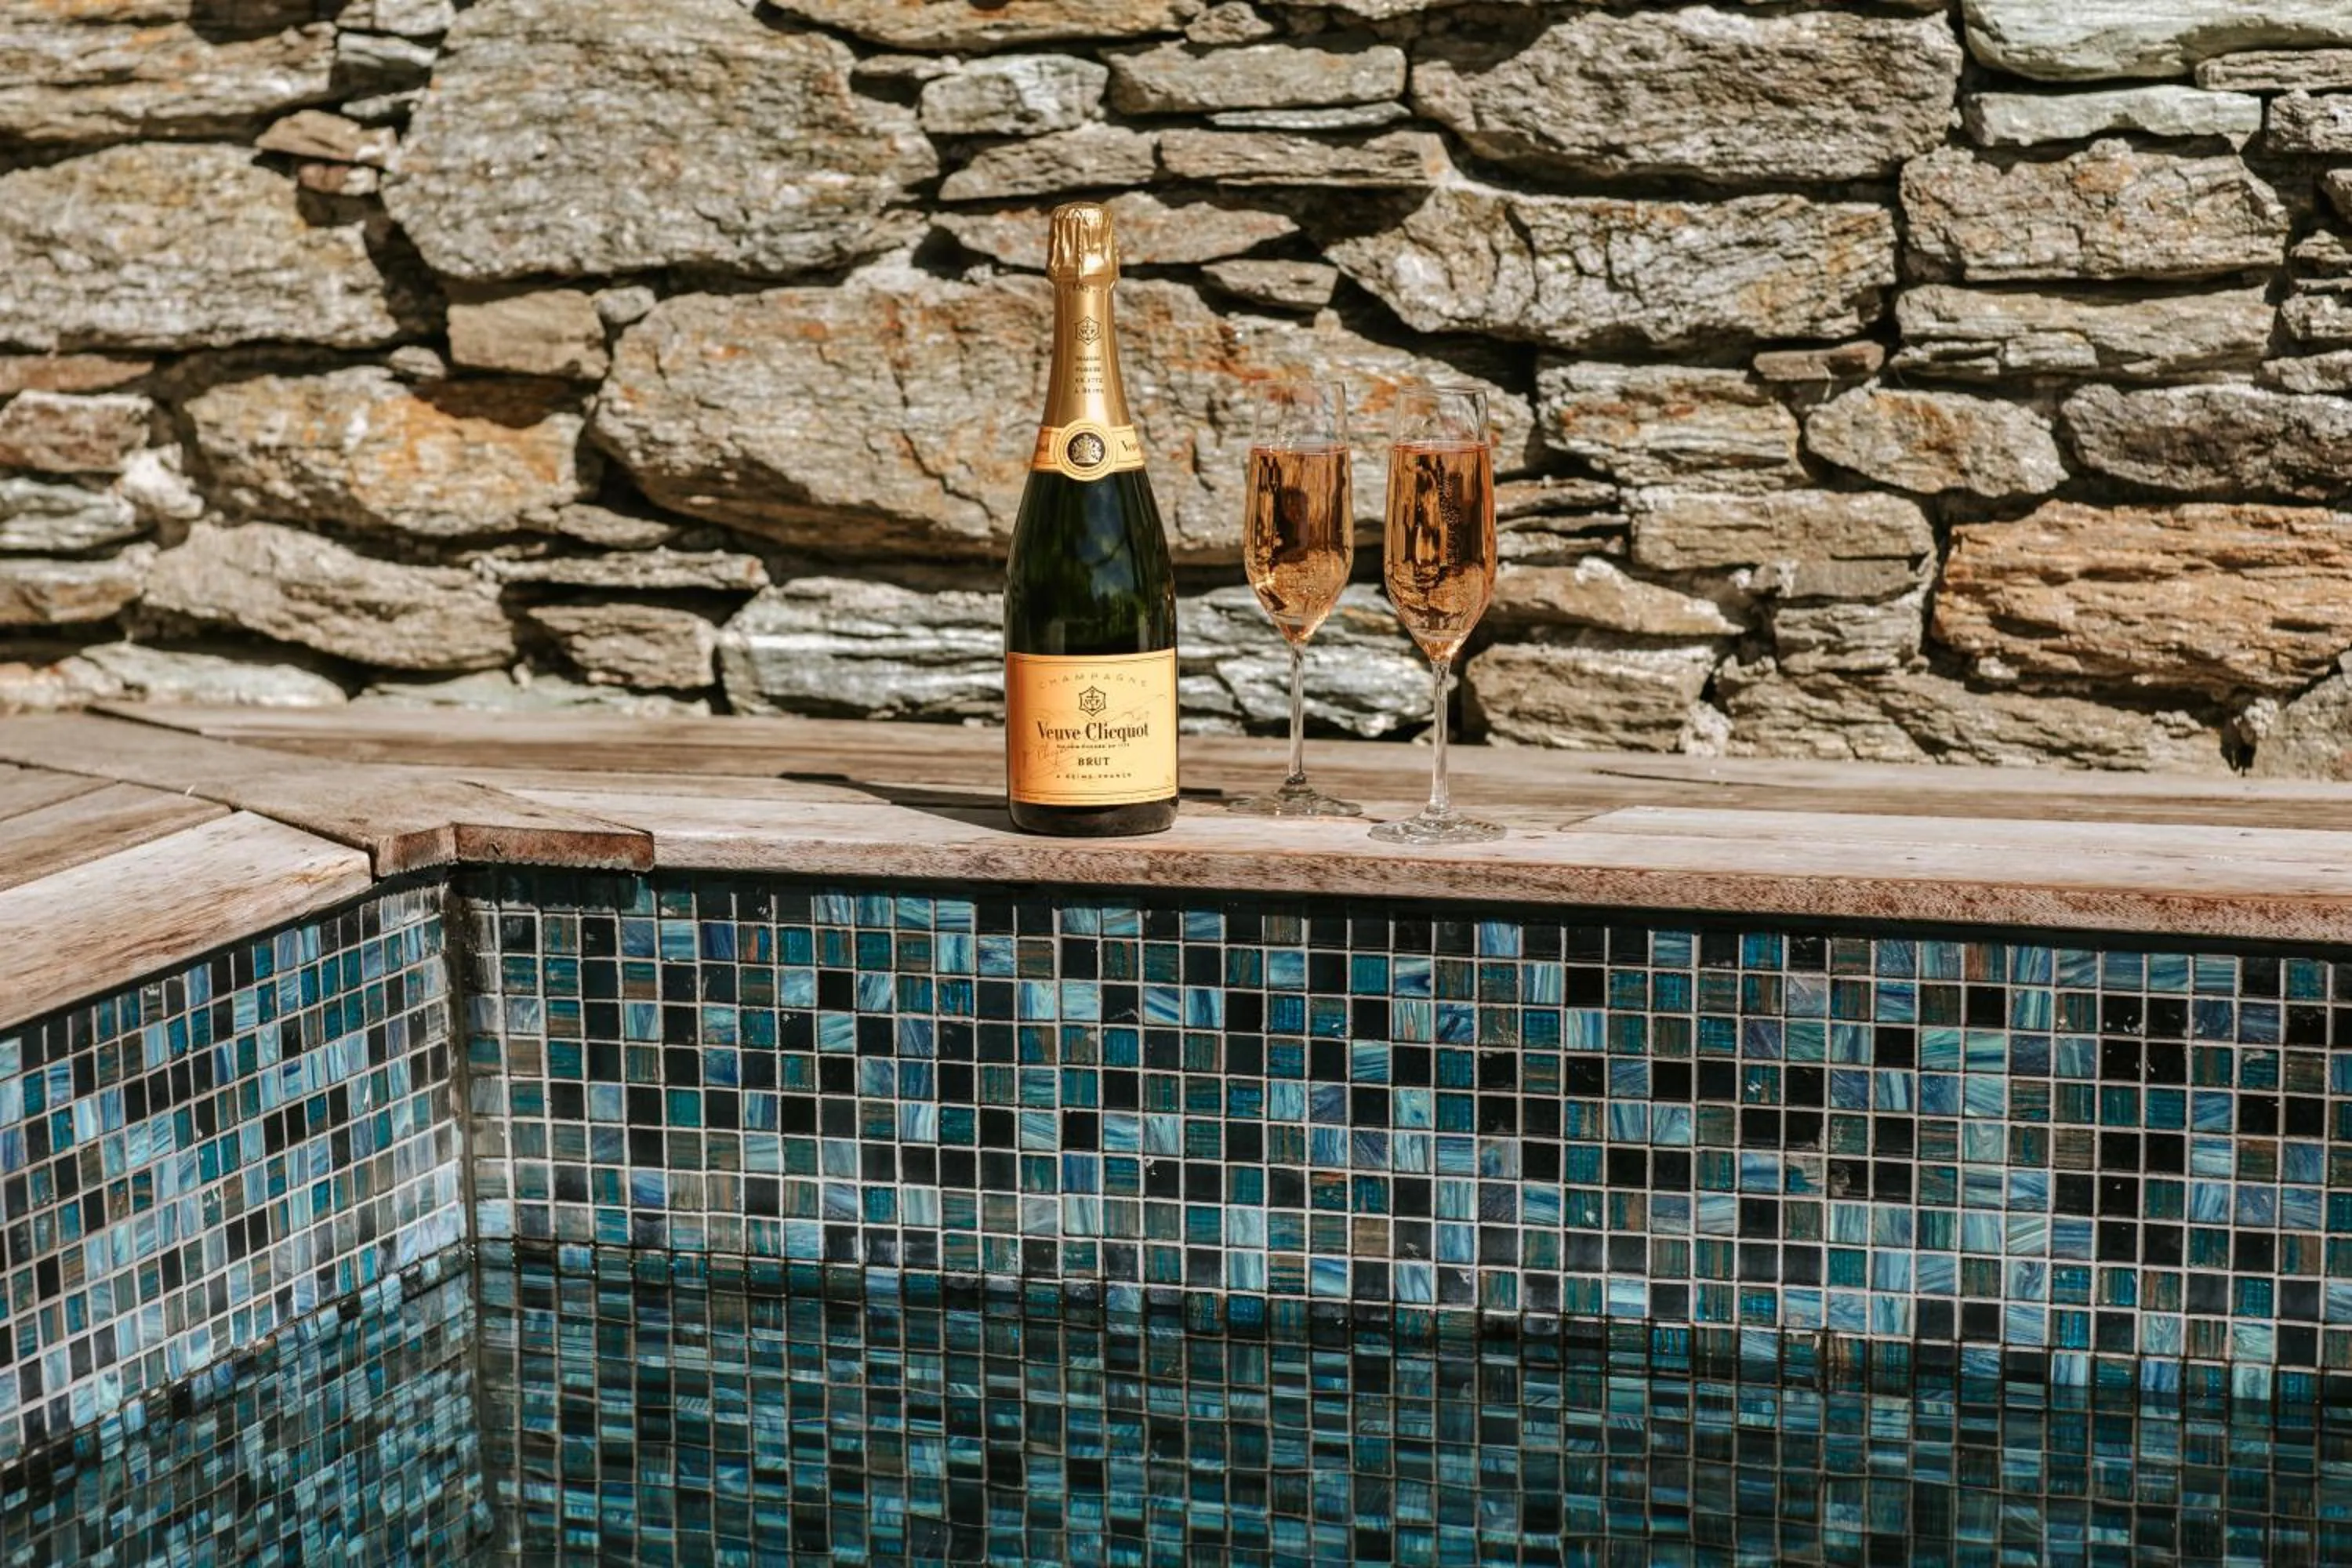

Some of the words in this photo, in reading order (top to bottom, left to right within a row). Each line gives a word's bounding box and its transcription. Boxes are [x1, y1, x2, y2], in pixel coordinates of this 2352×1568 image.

[1040, 673, 1147, 689] CHAMPAGNE
[1037, 720, 1081, 740] Veuve
[1086, 721, 1149, 742] Clicquot
[1078, 757, 1111, 766] BRUT
